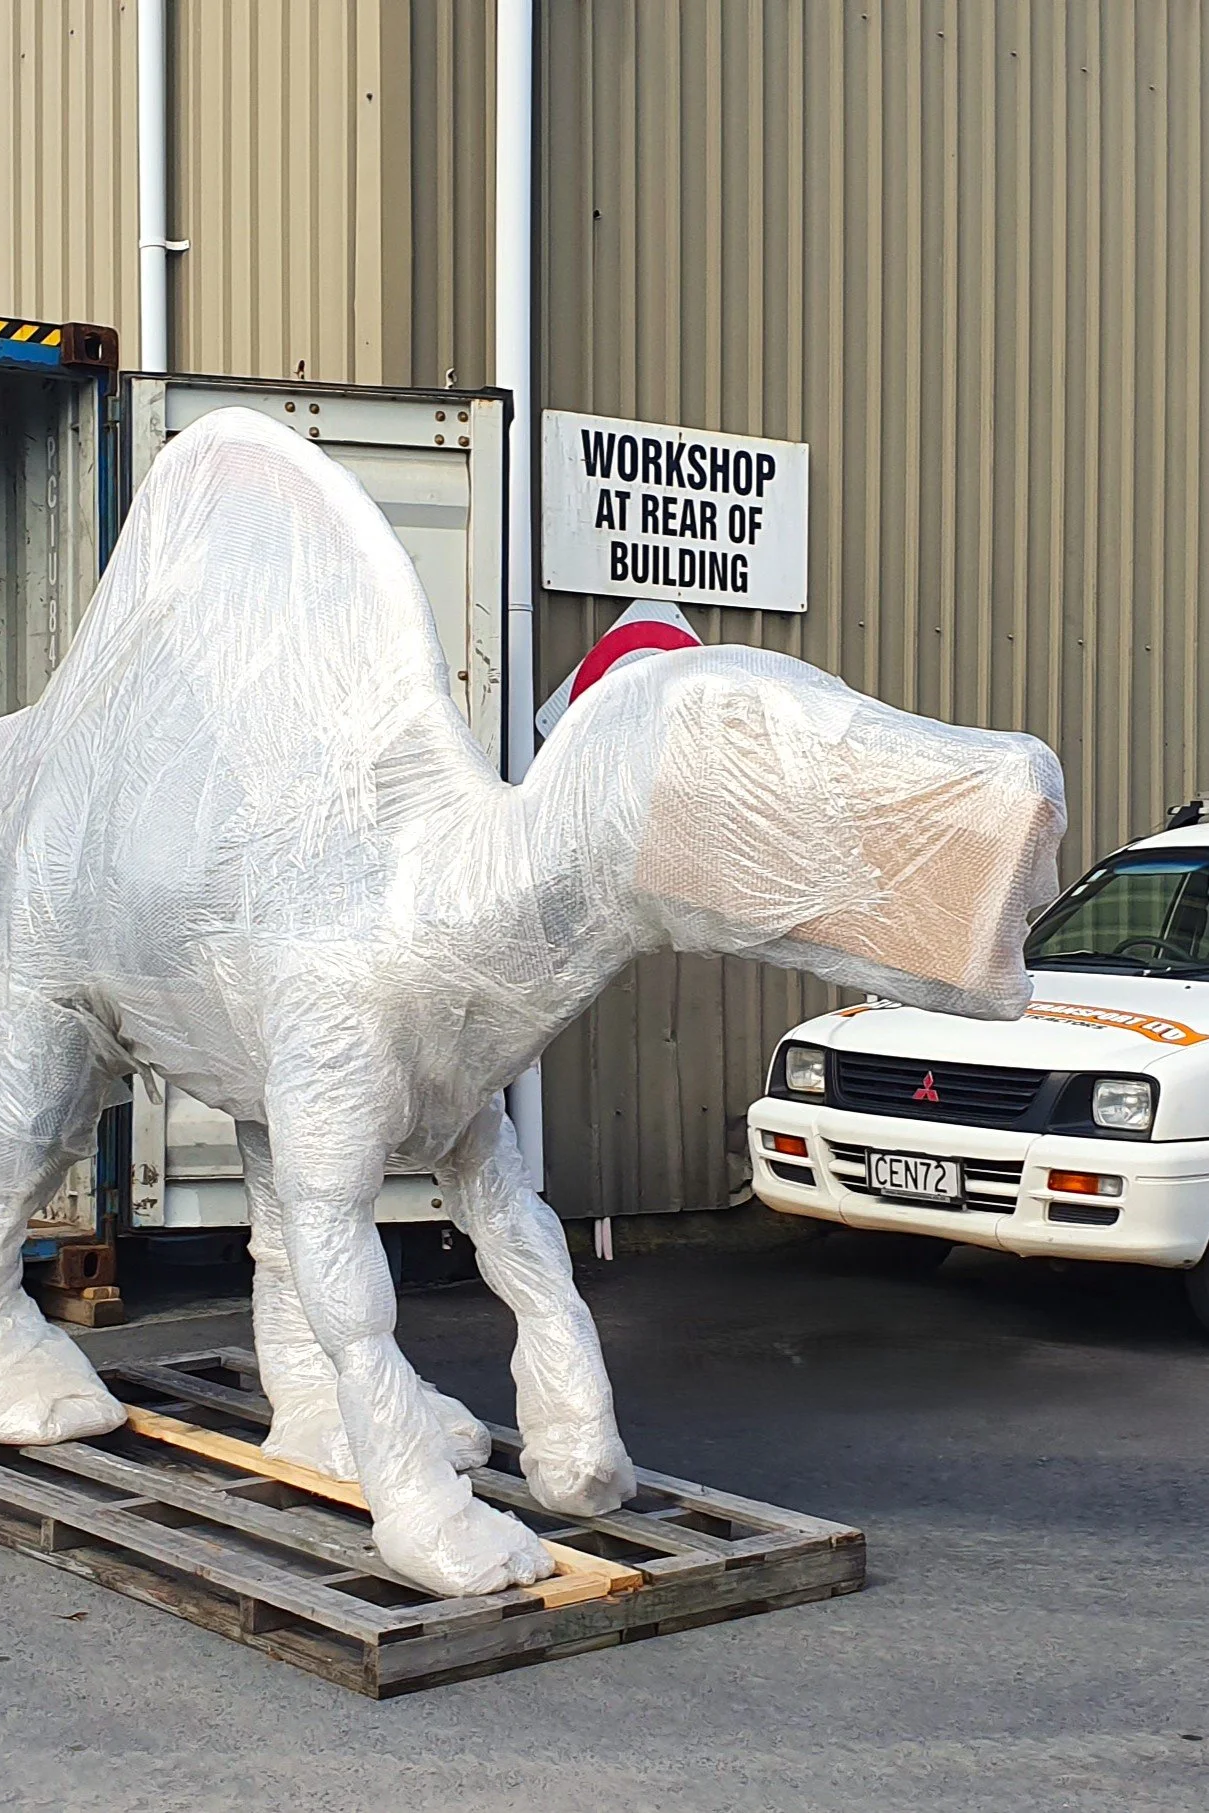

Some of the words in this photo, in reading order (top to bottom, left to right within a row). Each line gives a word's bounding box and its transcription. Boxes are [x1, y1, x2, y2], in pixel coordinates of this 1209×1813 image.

[580, 428, 776, 498] WORKSHOP
[595, 488, 631, 531] AT
[641, 493, 717, 541] REAR
[728, 503, 763, 545] OF
[610, 540, 748, 593] BUILDING
[1142, 1020, 1187, 1041] LTD
[875, 1156, 947, 1193] CEN72
